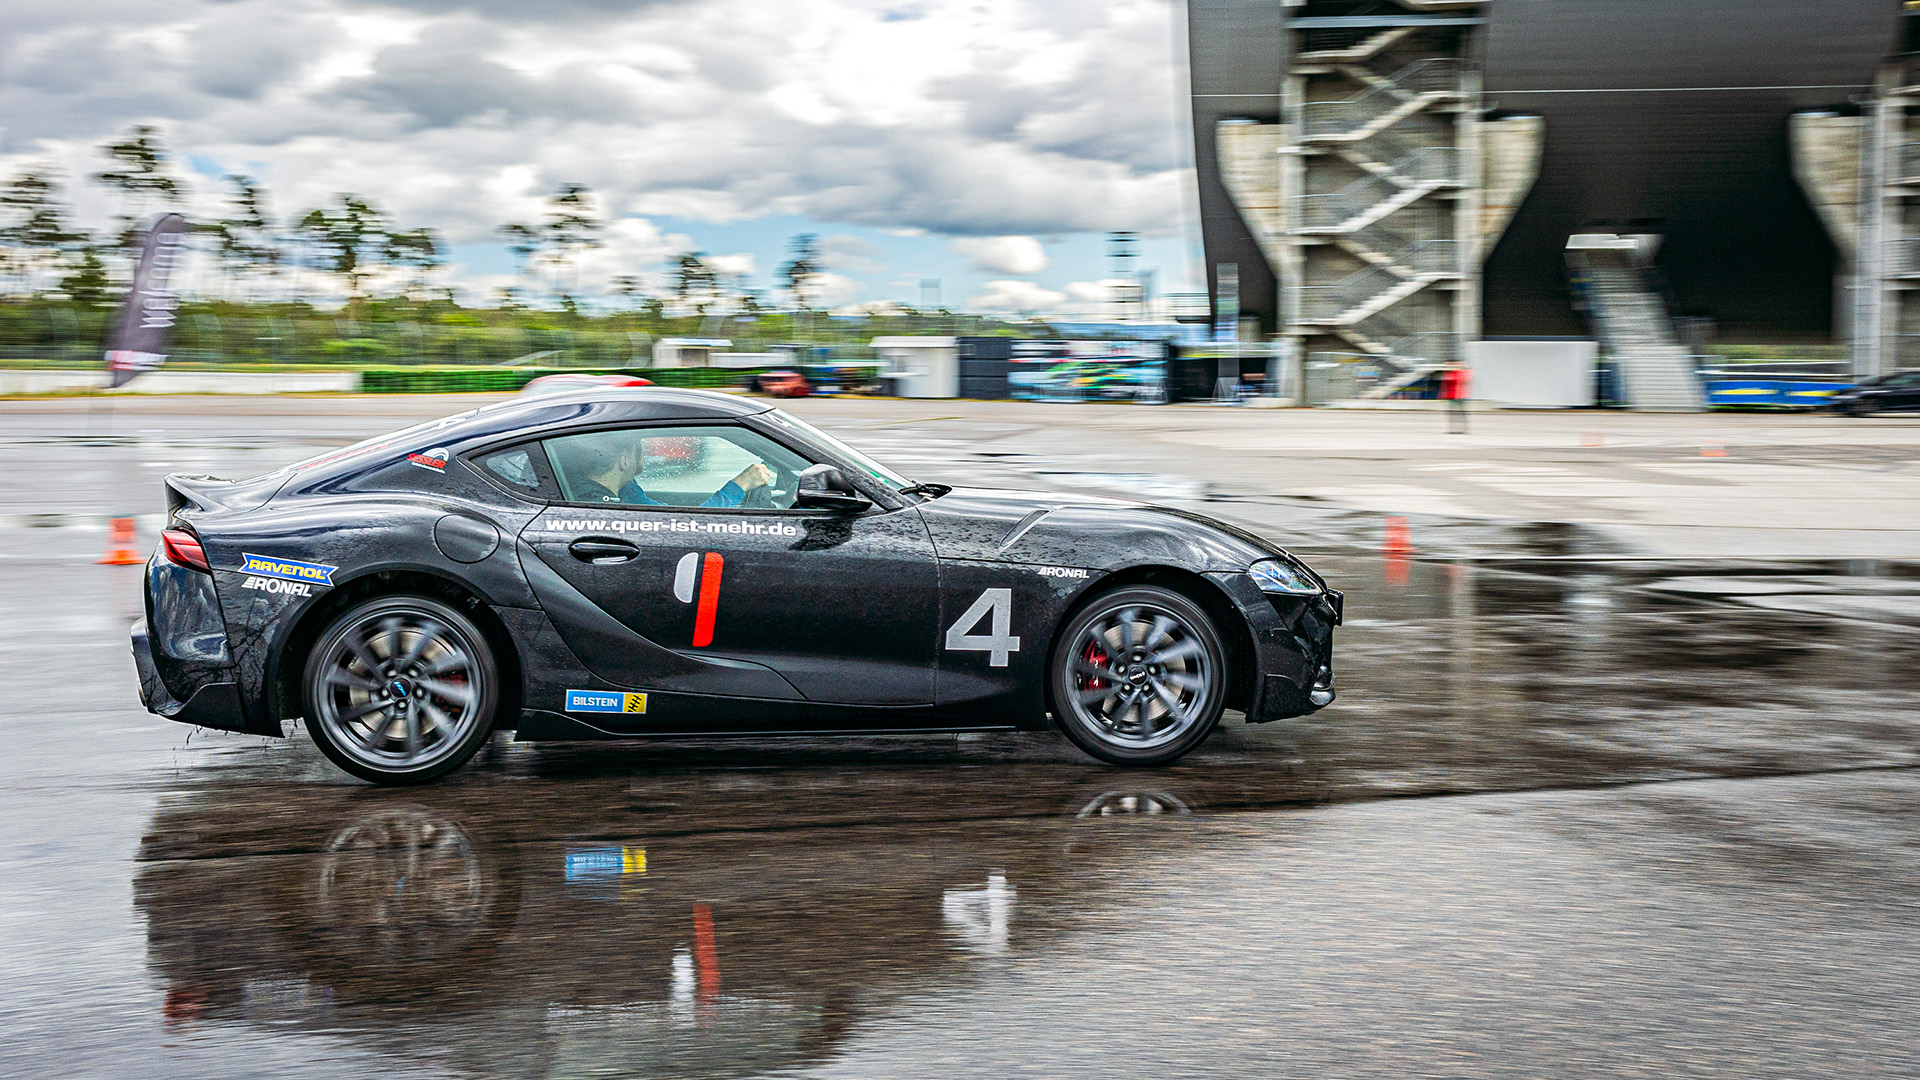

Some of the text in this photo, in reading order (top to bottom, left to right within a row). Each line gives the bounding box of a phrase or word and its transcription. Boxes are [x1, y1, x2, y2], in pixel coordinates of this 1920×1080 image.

[406, 453, 447, 469] SESSLER
[544, 518, 797, 536] www.quer-ist-mehr.de
[248, 559, 326, 580] RAVENOL
[1044, 566, 1090, 578] RONAL
[251, 577, 312, 597] RONAL
[945, 587, 1021, 667] 4
[572, 696, 618, 707] BILSTEIN
